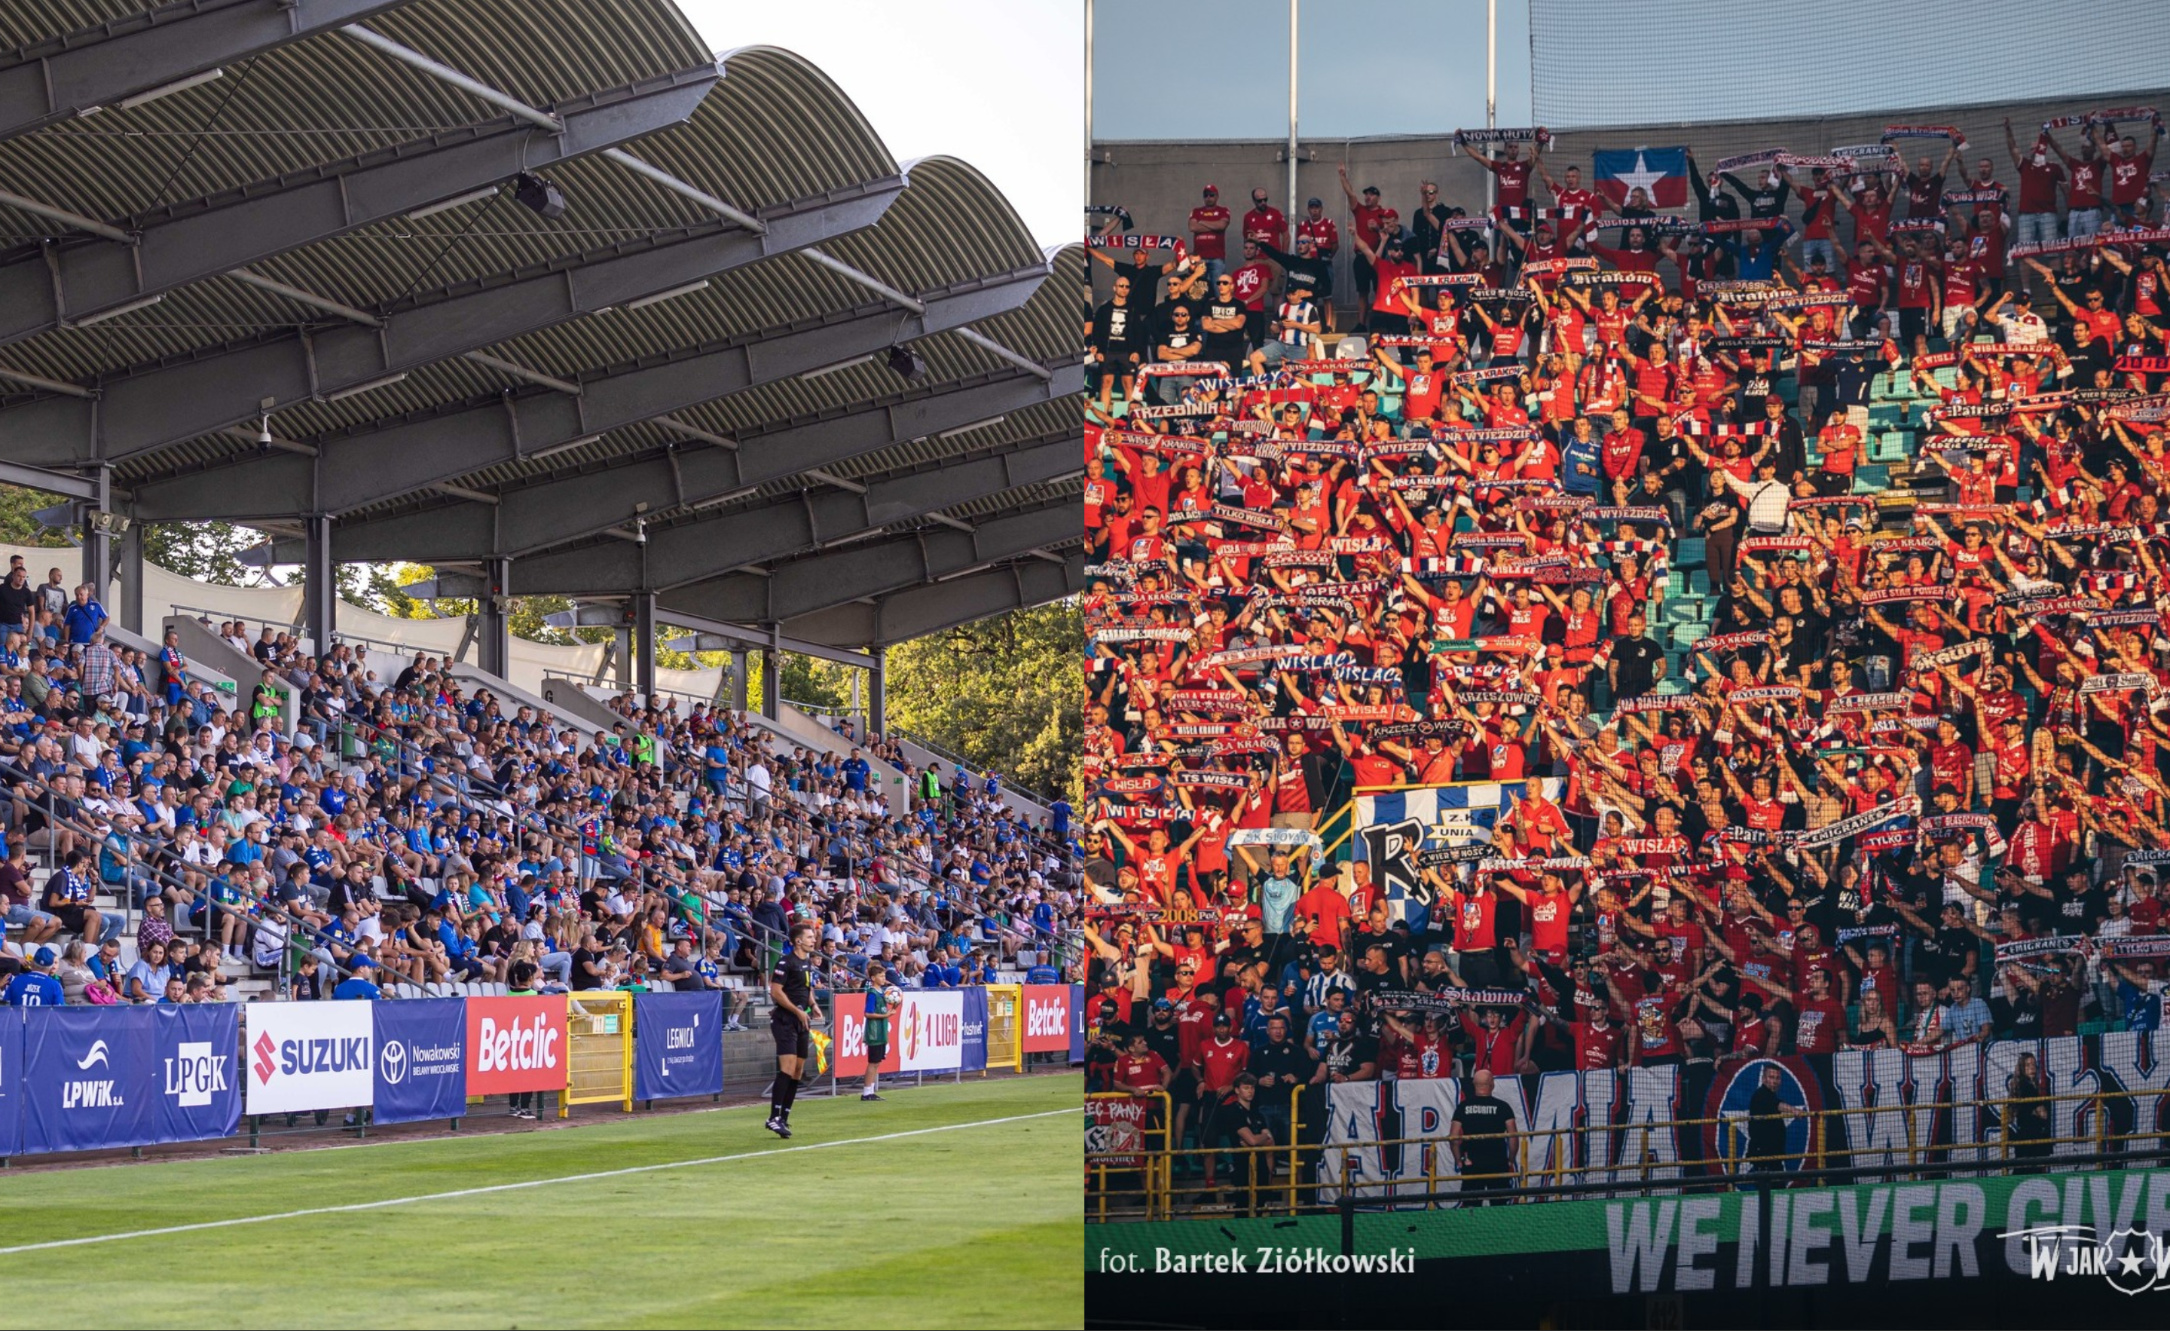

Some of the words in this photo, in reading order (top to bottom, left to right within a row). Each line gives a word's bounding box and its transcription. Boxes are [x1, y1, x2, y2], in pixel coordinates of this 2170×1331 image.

[1089, 236, 1174, 249] WISŁA
[1214, 506, 1244, 520] TYLKO
[1331, 535, 1383, 553] WISŁA
[545, 691, 553, 704] G
[1115, 779, 1152, 790] WISŁA
[1182, 774, 1197, 783] TS
[1200, 774, 1244, 786] WISŁA
[1107, 805, 1193, 820] WISŁA
[1440, 828, 1474, 836] UNIA
[1625, 839, 1677, 853] WISŁA
[1158, 910, 1199, 923] 2008
[1443, 986, 1523, 1004] Skawina
[1027, 996, 1066, 1037] Betclic
[667, 1027, 695, 1049] LEGNICA
[925, 1014, 931, 1047] 1
[936, 1013, 958, 1047] LIGA
[478, 1012, 558, 1072] Betclic
[281, 1037, 368, 1075] SUZUKI
[412, 1043, 460, 1063] Nowakowski
[165, 1055, 227, 1095] LPGK
[63, 1080, 114, 1108] LPWiK
[1109, 1101, 1144, 1121] PANY
[1465, 1105, 1497, 1115] SECURITY
[1317, 1066, 1682, 1211] ARMIA
[1606, 1196, 1721, 1293] WE
[1736, 1182, 1986, 1288] NEVER
